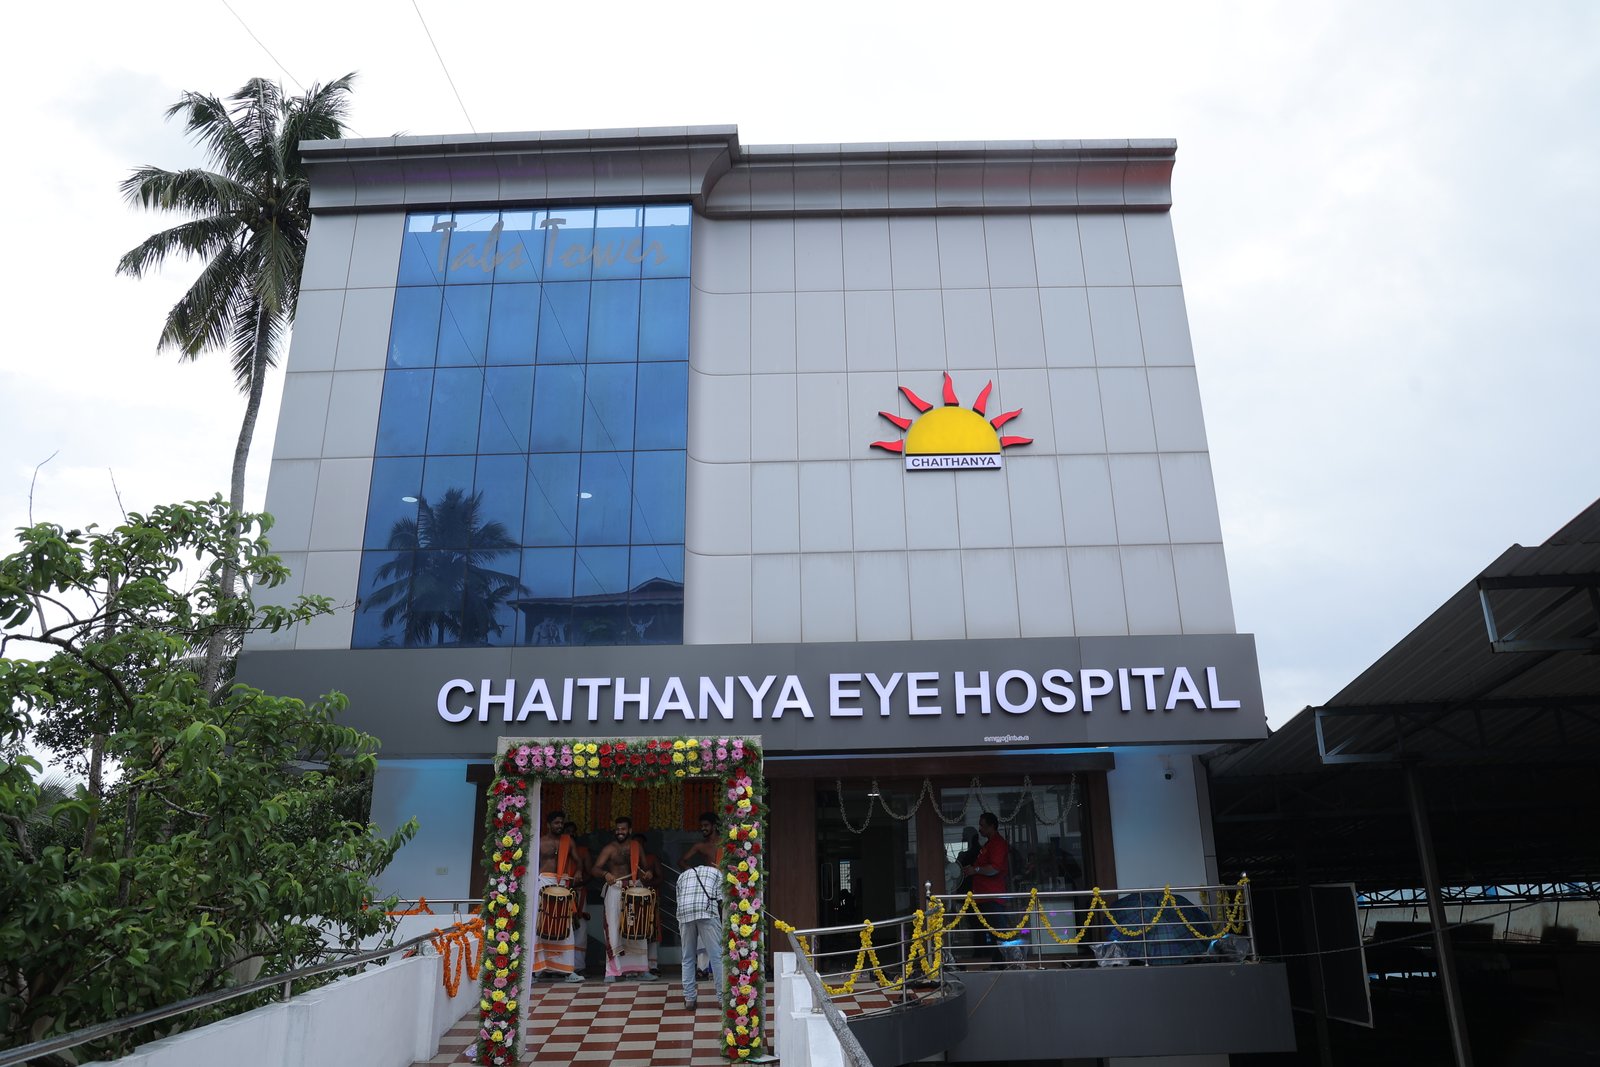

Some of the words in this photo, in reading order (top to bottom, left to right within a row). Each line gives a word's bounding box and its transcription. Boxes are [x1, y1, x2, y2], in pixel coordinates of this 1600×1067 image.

[540, 217, 669, 269] Tower
[911, 456, 996, 467] CHAITHANYA
[436, 674, 815, 722] CHAITHANYA
[828, 671, 943, 717] EYE
[954, 665, 1242, 715] HOSPITAL
